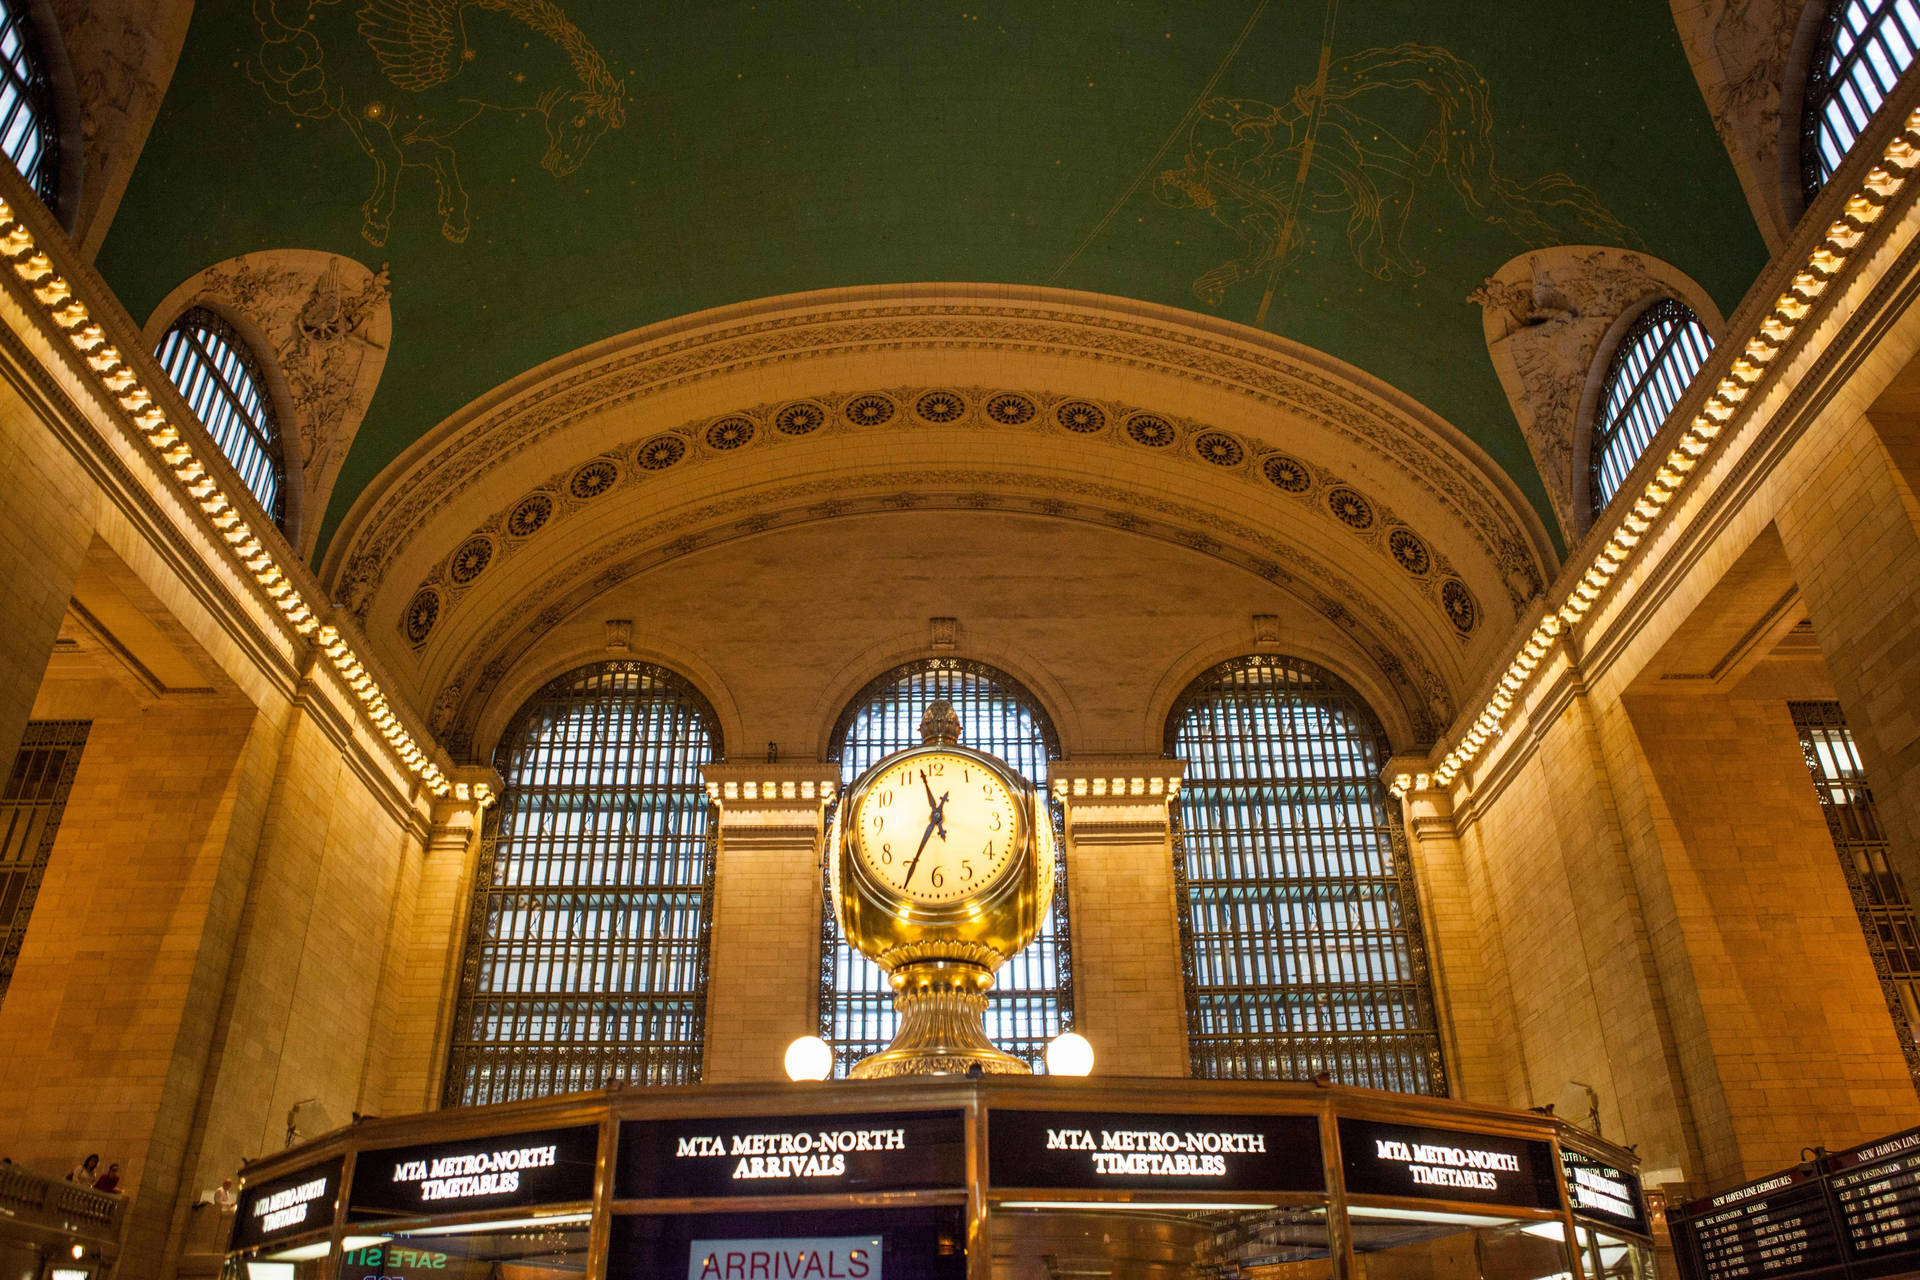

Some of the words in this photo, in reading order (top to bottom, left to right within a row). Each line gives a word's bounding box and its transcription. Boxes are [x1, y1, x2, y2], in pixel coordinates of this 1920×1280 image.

[901, 771, 912, 786] 11
[928, 763, 944, 777] 12
[879, 790, 893, 808] 10
[982, 785, 994, 801] 2
[873, 815, 884, 836] 9
[989, 811, 1001, 831] 3
[881, 843, 893, 865] 8
[982, 840, 996, 860] 4
[931, 865, 944, 888] 6
[960, 860, 973, 881] 5
[676, 1135, 726, 1157] MTA
[730, 1129, 905, 1156] METRO-NORTH
[1046, 1129, 1097, 1150] MTA
[1100, 1130, 1266, 1153] METRO-NORTH
[1857, 1148, 1876, 1162] NEW
[1875, 1139, 1902, 1157] HAVEN
[392, 1160, 428, 1182] MTA
[429, 1145, 557, 1178] METRO-NORTH
[732, 1154, 846, 1179] ARRIVALS
[1092, 1153, 1227, 1176] TIMETABLES
[1375, 1140, 1412, 1161] MTA
[1411, 1143, 1520, 1172] METRO-NORTH
[1409, 1165, 1498, 1190] TIMETABLES
[1862, 1162, 1901, 1180] DESTINATION
[253, 1196, 270, 1217] MTA
[269, 1177, 327, 1213] METRO-NORTH
[420, 1171, 520, 1200] TIMETABLES
[1712, 1198, 1726, 1208] NEW
[1725, 1191, 1745, 1204] HAVEN
[1743, 1187, 1757, 1198] LINE
[1756, 1174, 1792, 1194] DEPARTURES
[262, 1202, 309, 1233] TIMETABLES
[700, 1249, 870, 1280] ARRIVALS
